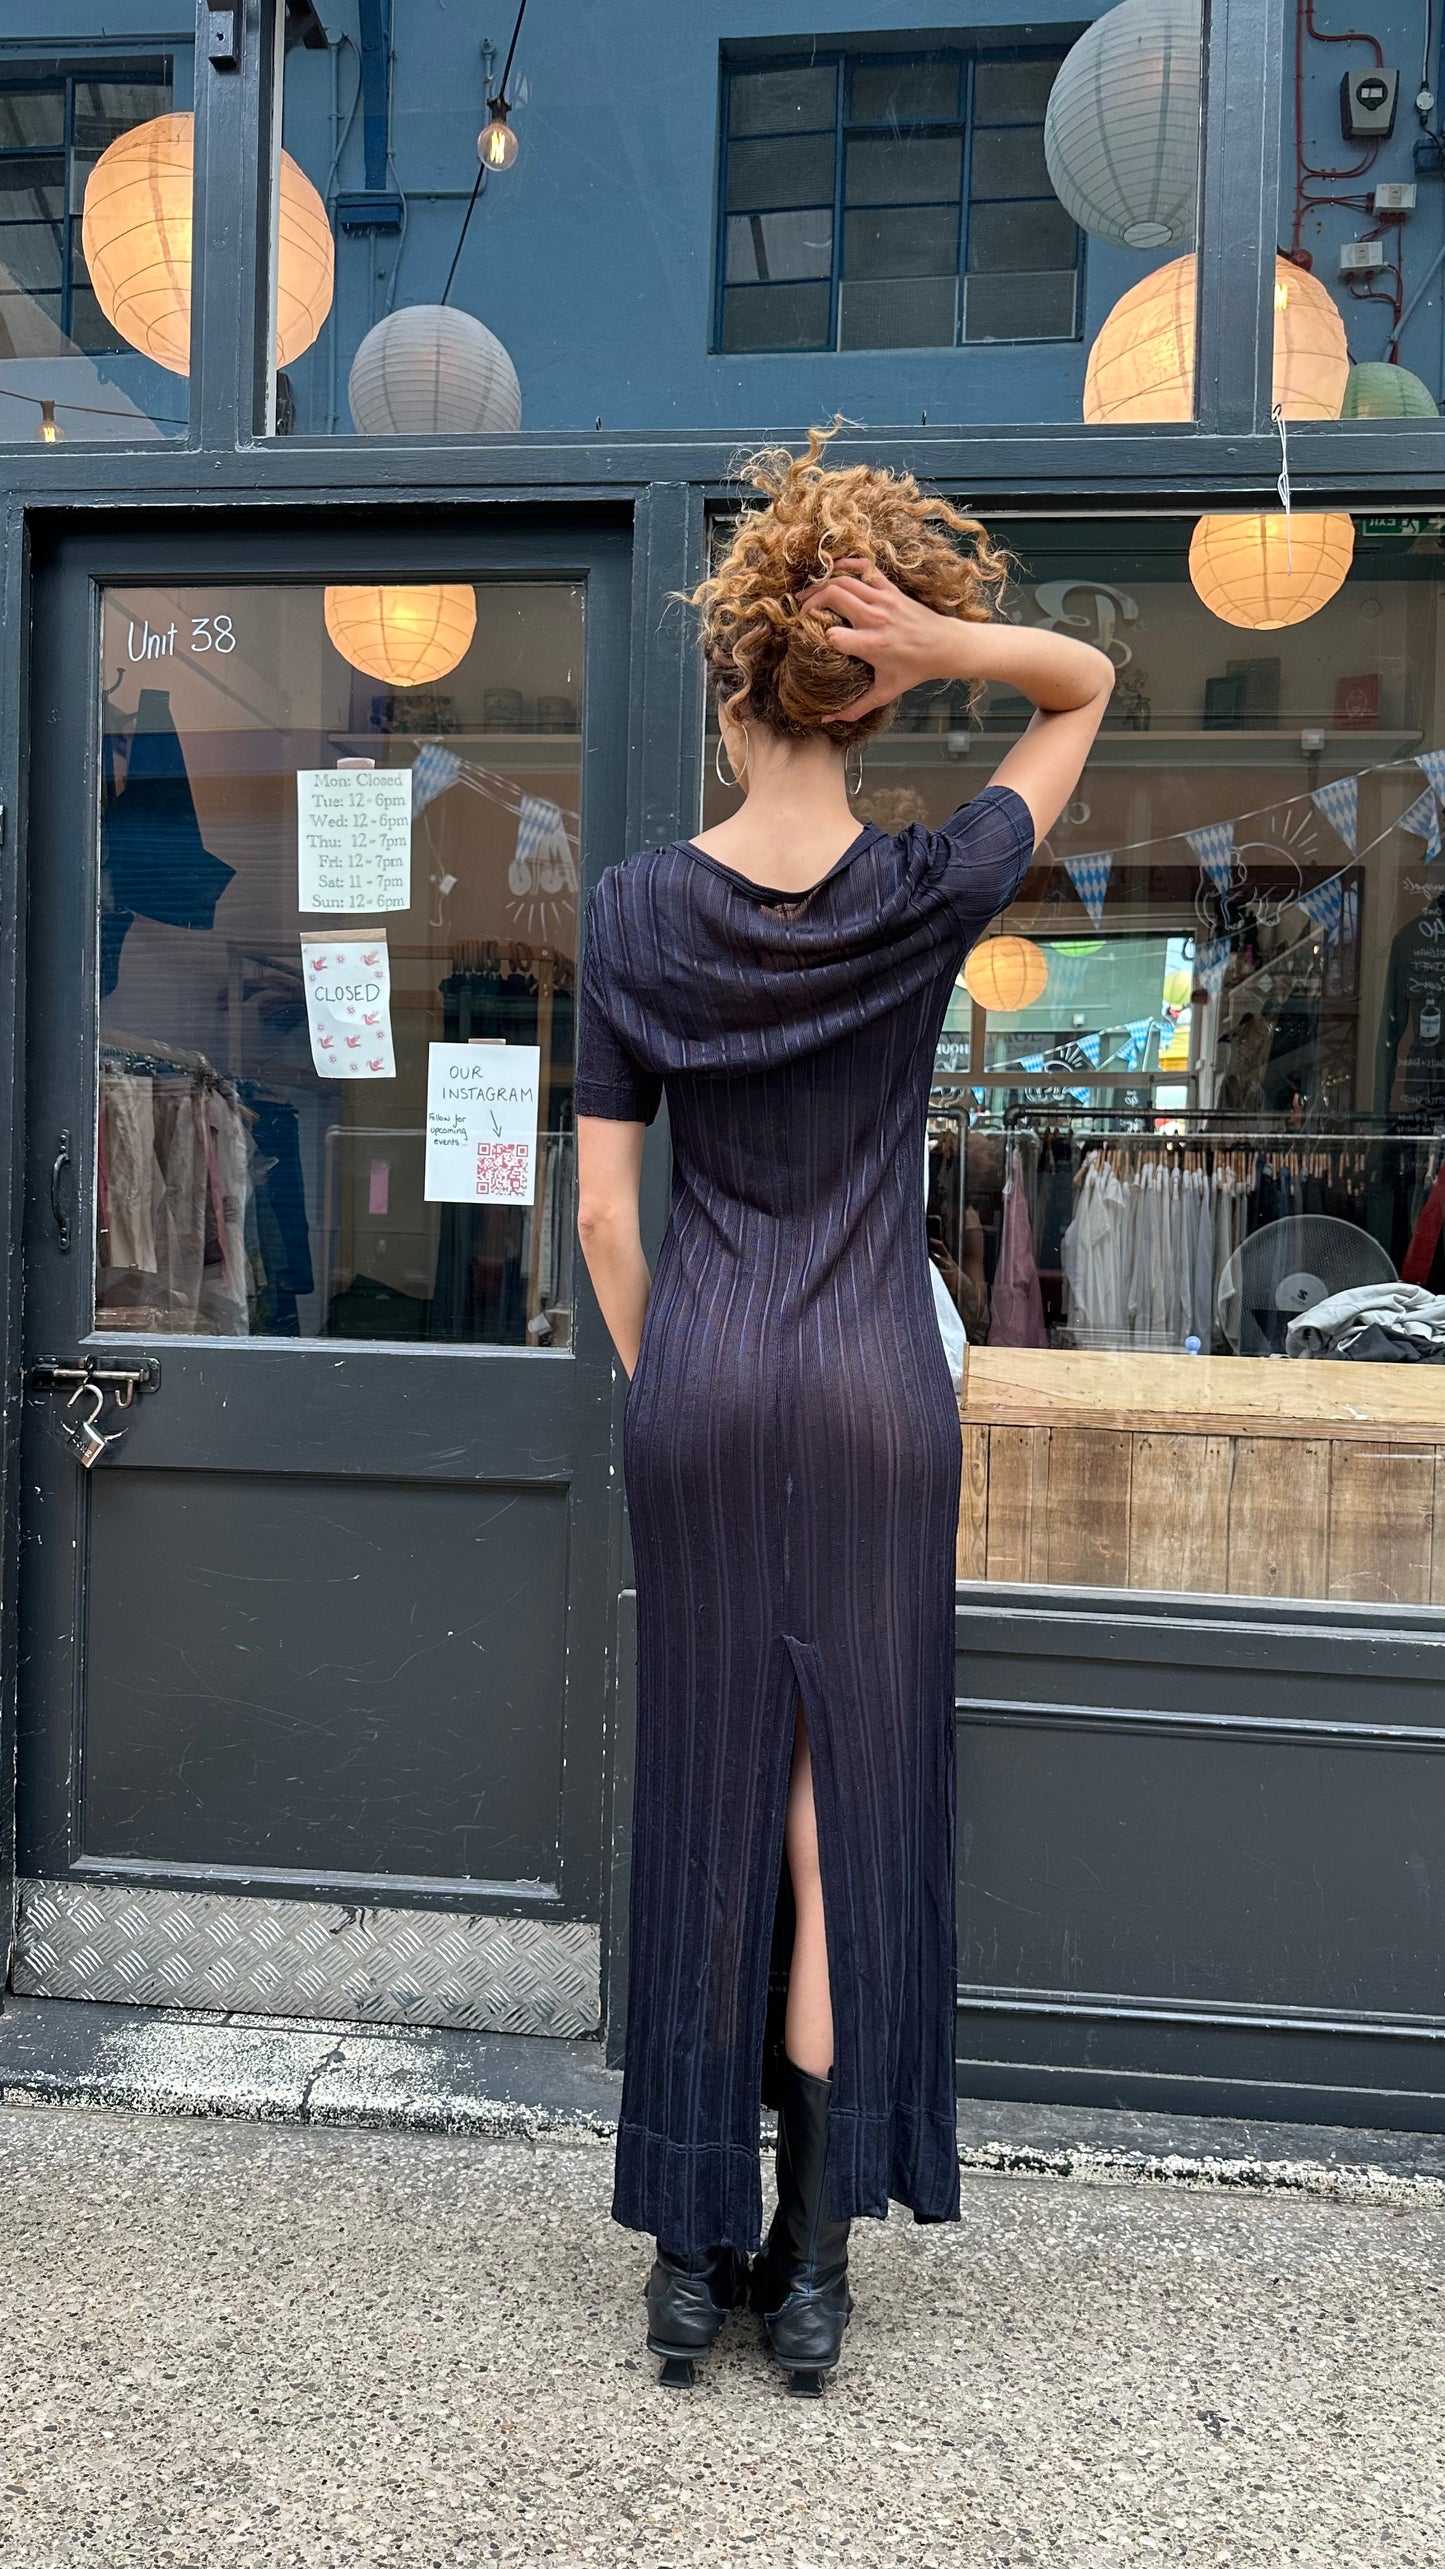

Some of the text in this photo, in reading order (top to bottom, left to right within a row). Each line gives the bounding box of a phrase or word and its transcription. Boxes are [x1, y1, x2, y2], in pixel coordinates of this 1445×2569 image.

[128, 615, 237, 662] Unit 38
[314, 773, 402, 787] Mon: Closed
[312, 794, 344, 807] Tue:
[349, 793, 365, 807] 12
[375, 793, 406, 810] 6pm
[309, 814, 349, 828] Wed:
[353, 813, 368, 828] 12
[379, 814, 409, 830] 6pm
[306, 834, 341, 848] Thu:
[352, 833, 367, 848] 12
[379, 834, 407, 851] 7pm
[319, 855, 343, 868] Fri:
[348, 854, 364, 868] 12
[375, 854, 404, 871] 7pm
[318, 875, 344, 888] Sat:
[349, 875, 362, 888] 11
[376, 875, 403, 891] 7pm
[312, 895, 344, 908] Sun:
[350, 894, 365, 908] 12
[377, 894, 405, 911] 6pm
[314, 983, 381, 1002] CLOSED
[449, 1065, 484, 1080] OUR
[442, 1086, 534, 1102] INSTAGRAM
[429, 1113, 467, 1128] Follow for
[430, 1127, 468, 1141] upcoming
